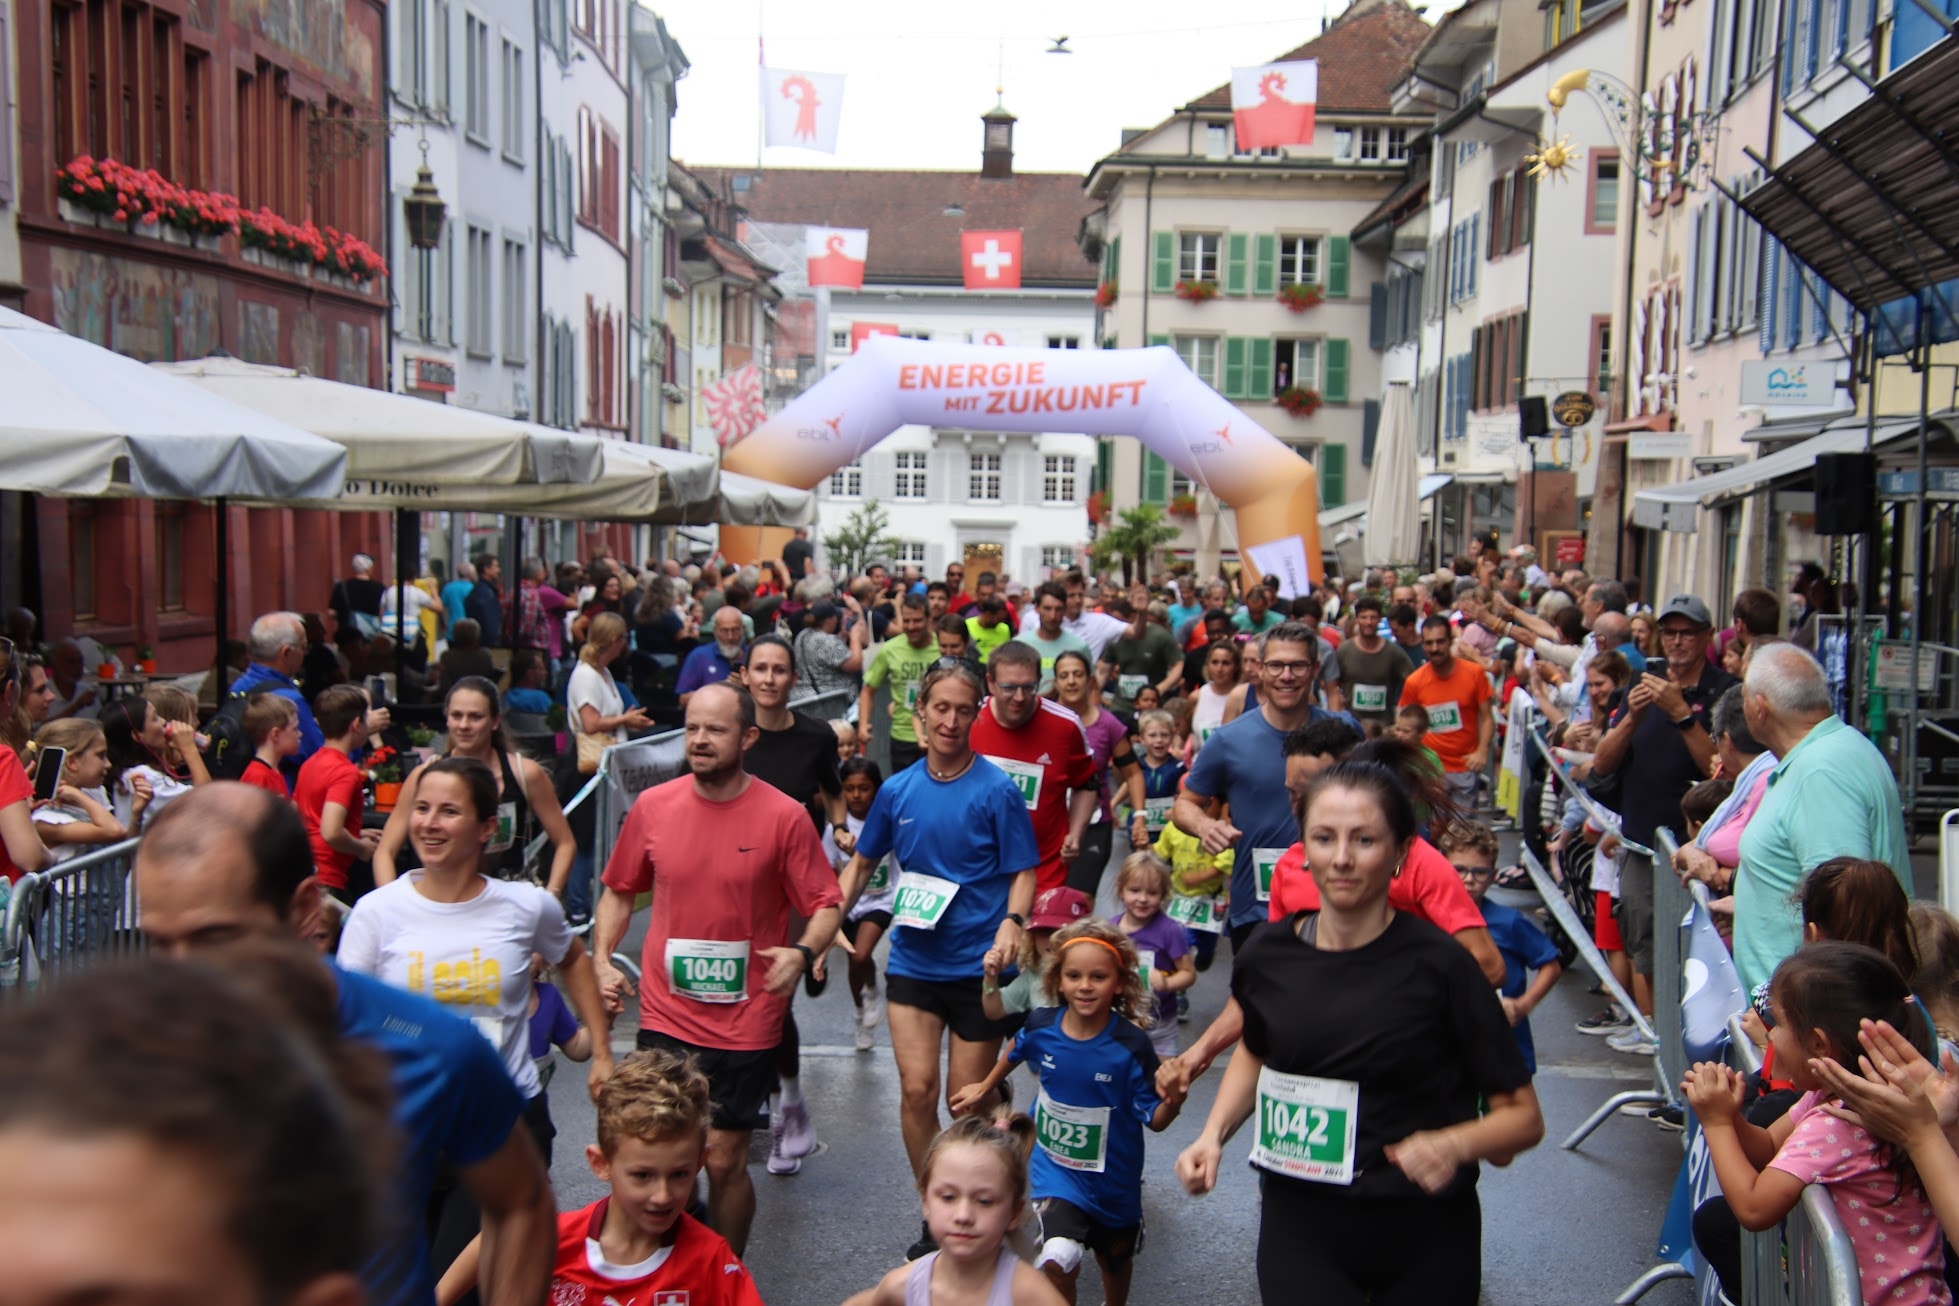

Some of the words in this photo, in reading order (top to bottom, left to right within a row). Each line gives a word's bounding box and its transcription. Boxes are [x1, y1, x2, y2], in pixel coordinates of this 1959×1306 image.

[898, 361, 1045, 390] ENERGIE
[944, 396, 981, 412] MIT
[985, 379, 1148, 415] ZUKUNFT
[369, 480, 440, 497] Dolce
[899, 887, 938, 912] 1070
[682, 957, 737, 982] 1040
[691, 982, 727, 992] MICHAEL
[1041, 1111, 1089, 1149] 1023
[1265, 1098, 1330, 1147] 1042
[1049, 1141, 1071, 1157] ENEA
[1271, 1138, 1312, 1160] SANDRA
